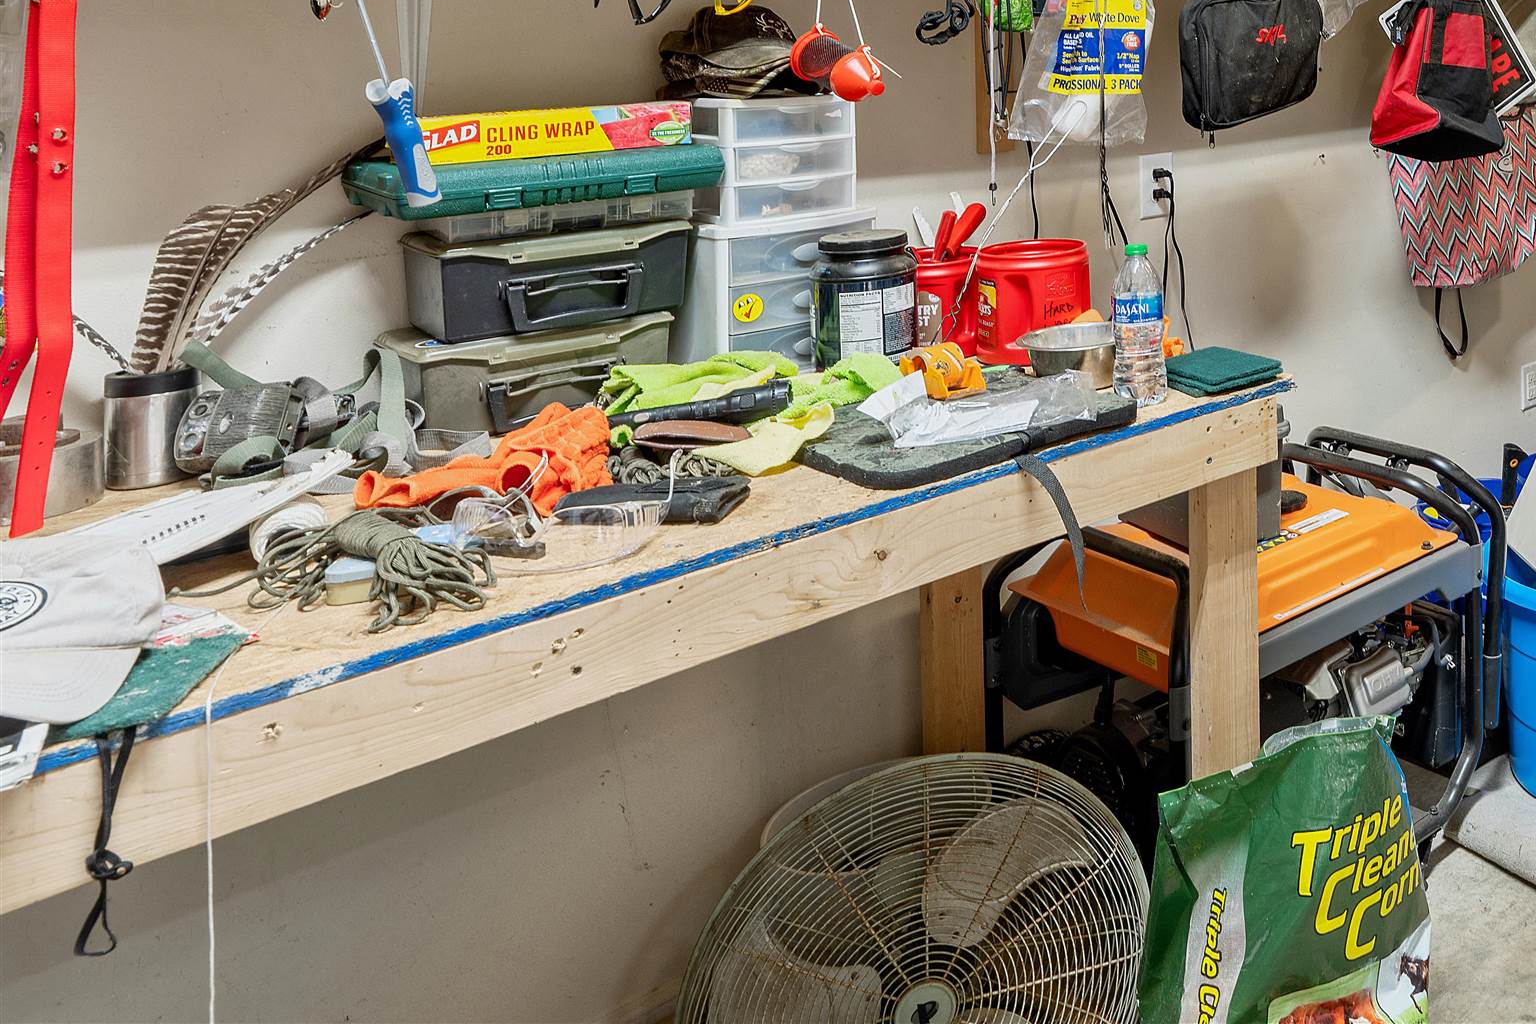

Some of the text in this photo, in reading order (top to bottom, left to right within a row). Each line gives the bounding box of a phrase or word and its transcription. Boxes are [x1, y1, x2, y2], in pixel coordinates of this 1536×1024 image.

[1118, 12, 1140, 23] Dove
[1111, 79, 1117, 90] 3
[1119, 79, 1142, 90] PACK
[487, 123, 538, 143] CLING
[545, 120, 595, 139] WRAP
[486, 144, 511, 156] 200
[1043, 301, 1074, 321] HARD
[1115, 303, 1149, 317] DASANI
[1292, 793, 1402, 897] Triple
[1344, 859, 1420, 961] Corn
[1200, 887, 1226, 978] Triple
